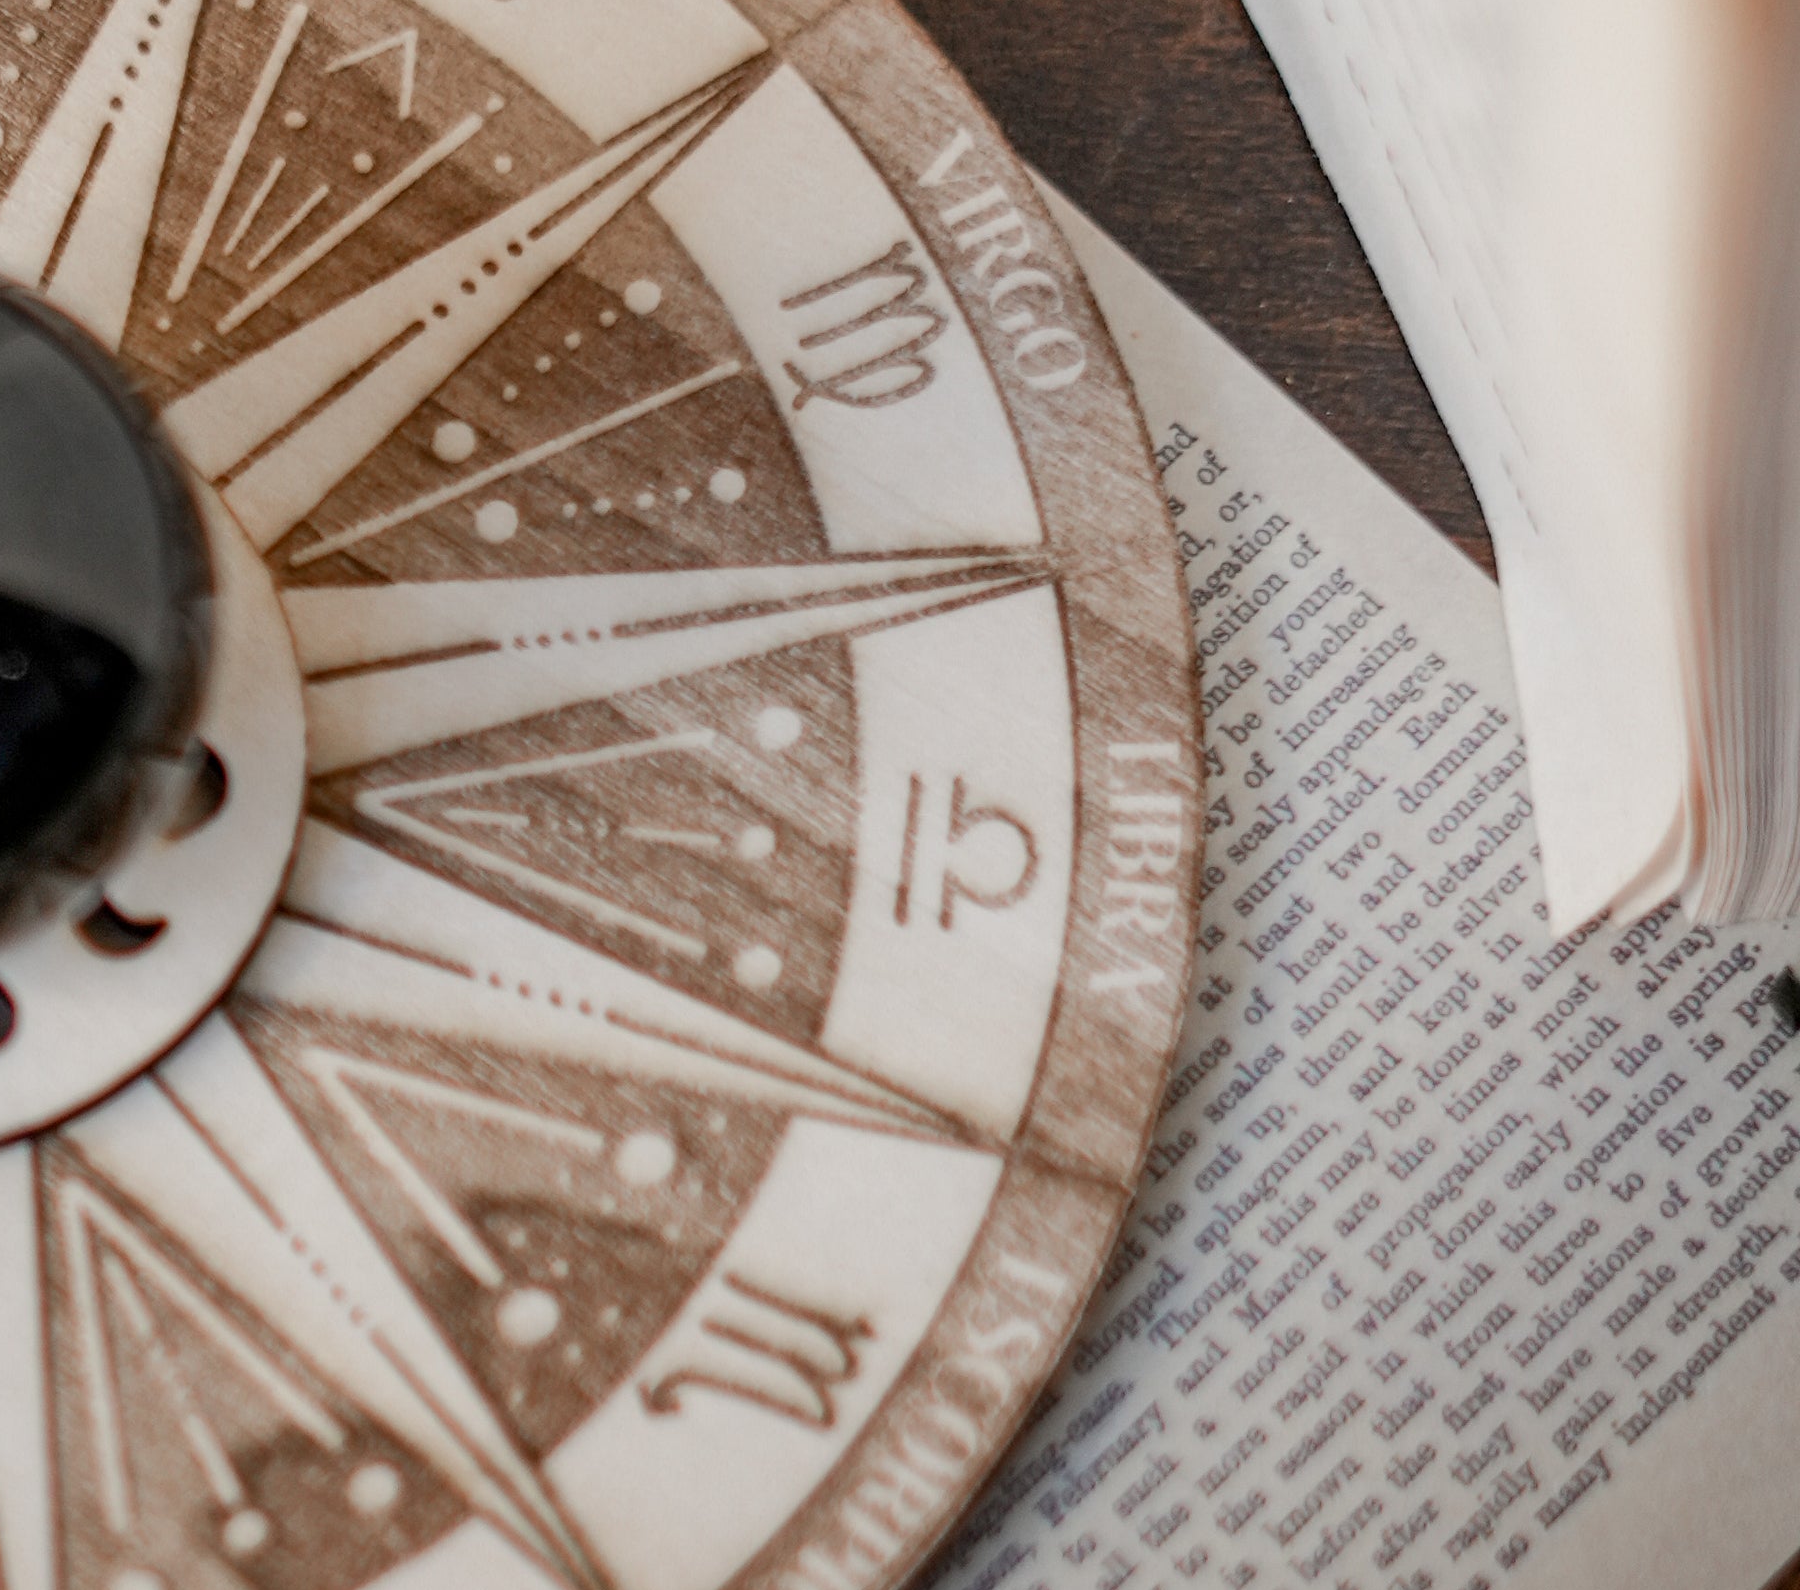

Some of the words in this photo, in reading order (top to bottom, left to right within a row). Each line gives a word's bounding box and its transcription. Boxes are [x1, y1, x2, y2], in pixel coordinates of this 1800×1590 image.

[917, 127, 1087, 391] VIRGO
[1218, 708, 1265, 746] be
[1267, 589, 1388, 708] detached
[1243, 750, 1277, 790] of
[1274, 621, 1420, 754] increasing
[1268, 565, 1358, 653] young
[1225, 792, 1299, 867] scaly
[1297, 649, 1450, 796] appendages
[1232, 774, 1390, 918] surrounded.
[1396, 678, 1481, 752] Each
[1236, 890, 1316, 964] least
[1323, 830, 1384, 882] two
[1395, 703, 1511, 818] dormant
[1086, 741, 1184, 1010] LIBRA
[1276, 919, 1350, 986] heat
[1359, 851, 1417, 912] and
[1194, 1141, 1245, 1194] cut
[1296, 1025, 1365, 1090] then
[1356, 965, 1424, 1026] laid
[1412, 937, 1455, 971] in
[1452, 862, 1530, 939] silver
[1202, 1041, 1287, 1126] scales
[1290, 944, 1384, 1039] should
[1375, 908, 1423, 946] be
[1315, 1129, 1378, 1193] may
[1412, 1029, 1483, 1094] done
[1347, 1042, 1405, 1103] and
[1407, 968, 1483, 1036] kept
[1503, 1118, 1574, 1193] early
[1571, 1084, 1614, 1119] in
[1609, 1031, 1664, 1080] the
[1667, 941, 1762, 1030] spring.
[1538, 1010, 1624, 1093] which
[1232, 1243, 1329, 1334] March
[1334, 1189, 1382, 1238] are
[1385, 1134, 1437, 1182] the
[1443, 1048, 1523, 1124] times
[1530, 970, 1603, 1042] most
[1497, 1198, 1559, 1254] this
[1562, 1070, 1689, 1193] operation
[1687, 1029, 1727, 1063] is
[1525, 1214, 1601, 1288] three
[1654, 1104, 1715, 1159] five
[1658, 1178, 1692, 1219] of
[1696, 1085, 1793, 1189] growth
